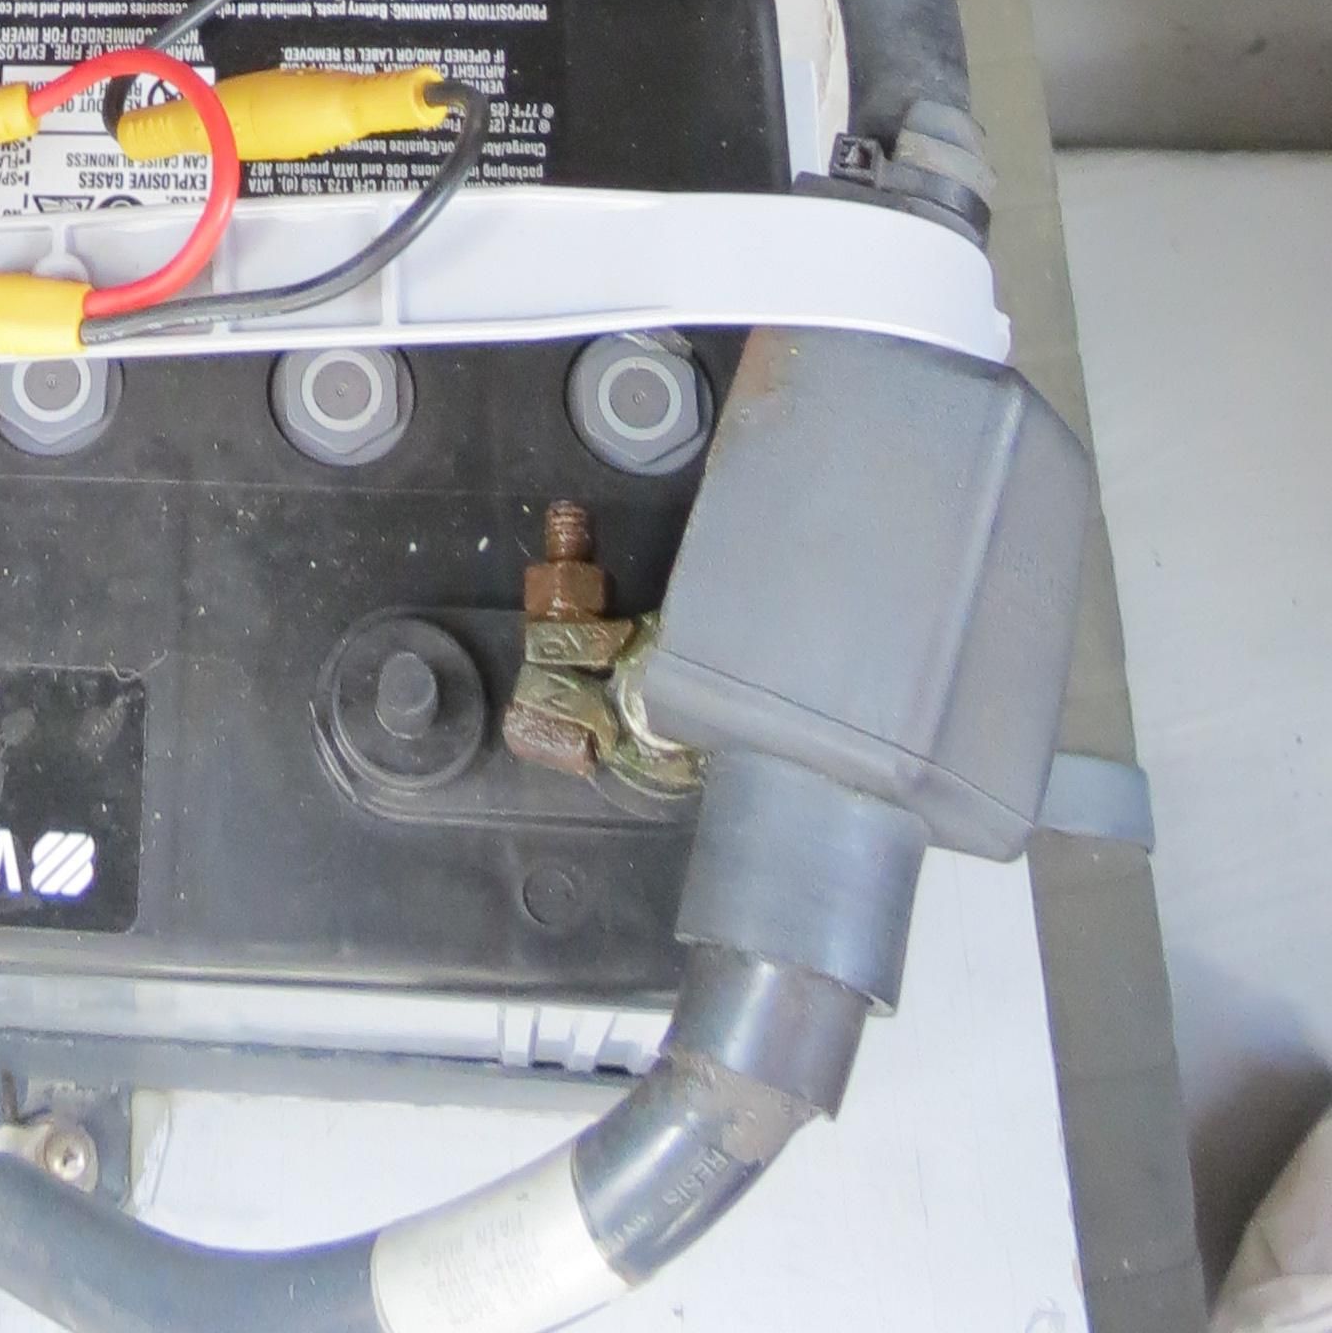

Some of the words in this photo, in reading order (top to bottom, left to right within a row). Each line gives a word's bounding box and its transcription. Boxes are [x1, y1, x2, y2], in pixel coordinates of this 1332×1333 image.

[15, 1, 37, 17] lead
[39, 1, 60, 17] and
[62, 1, 85, 17] lead
[88, 1, 128, 17] contain
[260, 3, 311, 19] terminals
[348, 0, 388, 19] Battery
[389, 2, 451, 19] WARNING:
[468, 3, 547, 20] PROPOSITION
[42, 27, 68, 43] FOR
[280, 46, 342, 62] REMOVED.
[358, 47, 393, 62] LABEL
[397, 47, 441, 62] AND/OR
[445, 48, 490, 63] OPENED
[275, 160, 329, 177] provision
[482, 159, 543, 179] packaging
[79, 172, 124, 189] GASES
[248, 178, 274, 194] IATA
